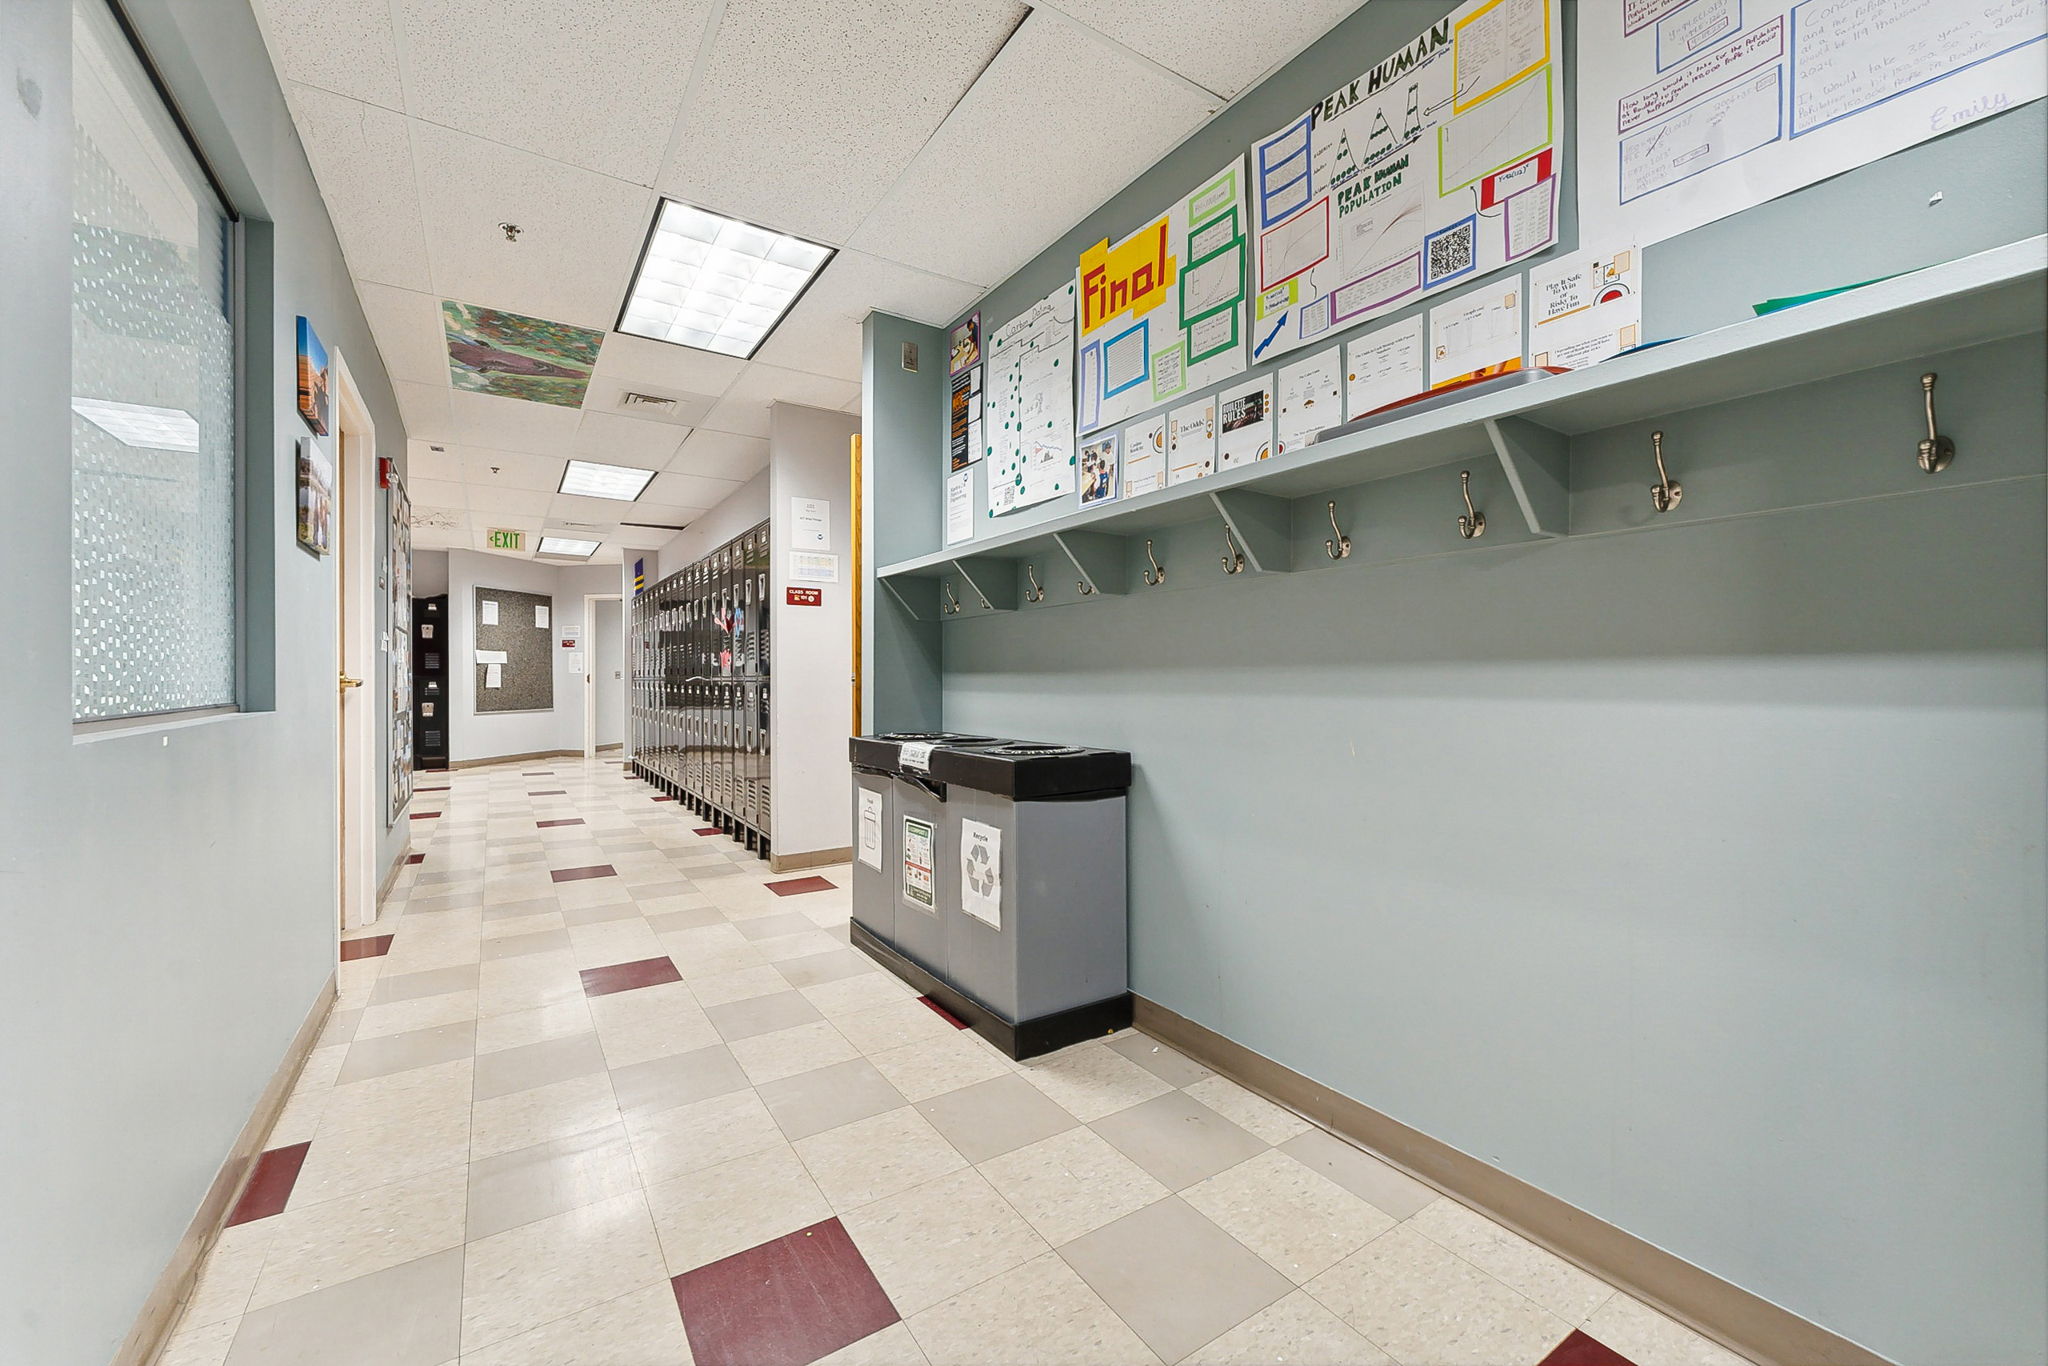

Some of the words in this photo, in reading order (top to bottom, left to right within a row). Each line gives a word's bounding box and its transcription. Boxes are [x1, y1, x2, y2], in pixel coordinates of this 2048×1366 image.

[1799, 58, 1833, 79] 2024
[1823, 70, 1857, 96] would
[1868, 56, 1897, 75] take
[1937, 20, 1971, 42] years
[1310, 78, 1360, 131] PEAK
[1367, 17, 1450, 93] HUMAN
[1622, 99, 1639, 112] How
[1643, 91, 1658, 103] long
[1662, 76, 1683, 92] would
[1686, 70, 1692, 79] it
[1696, 60, 1712, 72] take
[1715, 52, 1728, 62] for
[1731, 44, 1742, 54] the
[1633, 99, 1657, 116] Boulder
[1670, 82, 1689, 98] reach
[1622, 113, 1641, 127] never
[1930, 93, 2015, 132] Emily
[1337, 175, 1372, 206] PEAK
[1374, 154, 1410, 183] HUMAN
[1339, 172, 1402, 218] POPULATION
[1083, 224, 1167, 330] Final
[1546, 282, 1559, 291] Play
[1567, 273, 1582, 282] Safe
[1562, 282, 1576, 291] Win
[1548, 306, 1565, 316] Have
[1566, 300, 1580, 310] Fun
[1550, 298, 1567, 309] Risky
[1005, 319, 1029, 337] Carbon
[1222, 407, 1247, 425] RULES
[494, 531, 521, 549] EXIT
